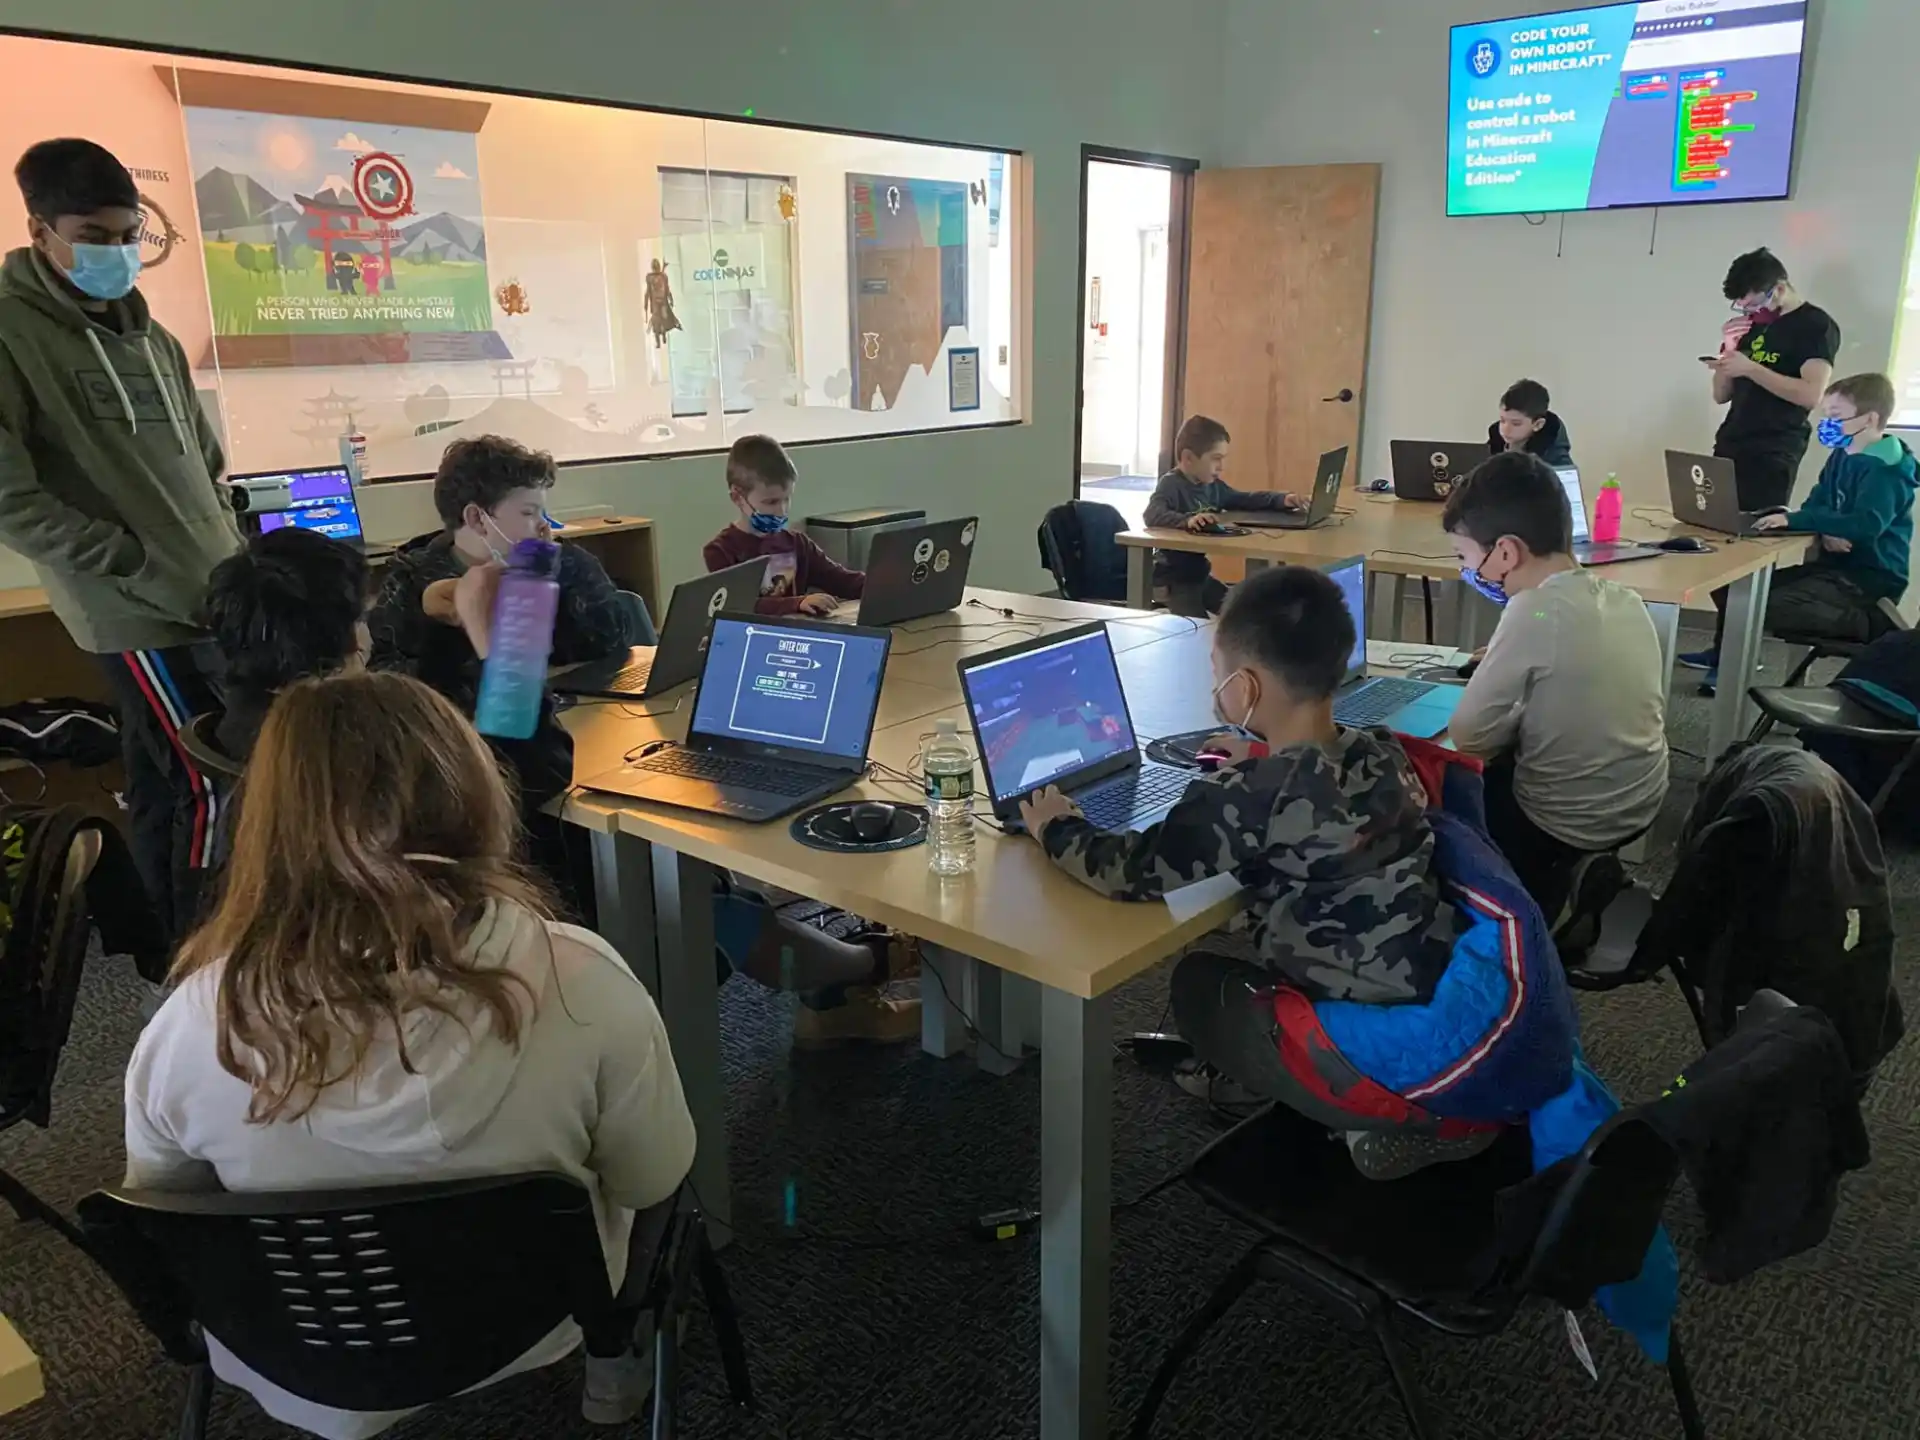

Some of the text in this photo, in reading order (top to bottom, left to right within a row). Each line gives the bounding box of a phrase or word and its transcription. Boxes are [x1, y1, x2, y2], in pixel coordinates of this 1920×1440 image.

[1511, 23, 1589, 43] CODE YOUR
[1510, 39, 1596, 59] OWN ROBOT
[1509, 64, 1524, 76] IN
[1467, 92, 1552, 111] Use code to
[1467, 108, 1576, 130] control a robot
[1466, 129, 1552, 149] in Minecraft
[1465, 150, 1536, 167] Education
[128, 168, 169, 182] THINESS
[256, 297, 455, 306] A PERSON WHO NEVER MADE A MISTAKE
[257, 307, 455, 320] NEVER TRIED ANYTHING NEW
